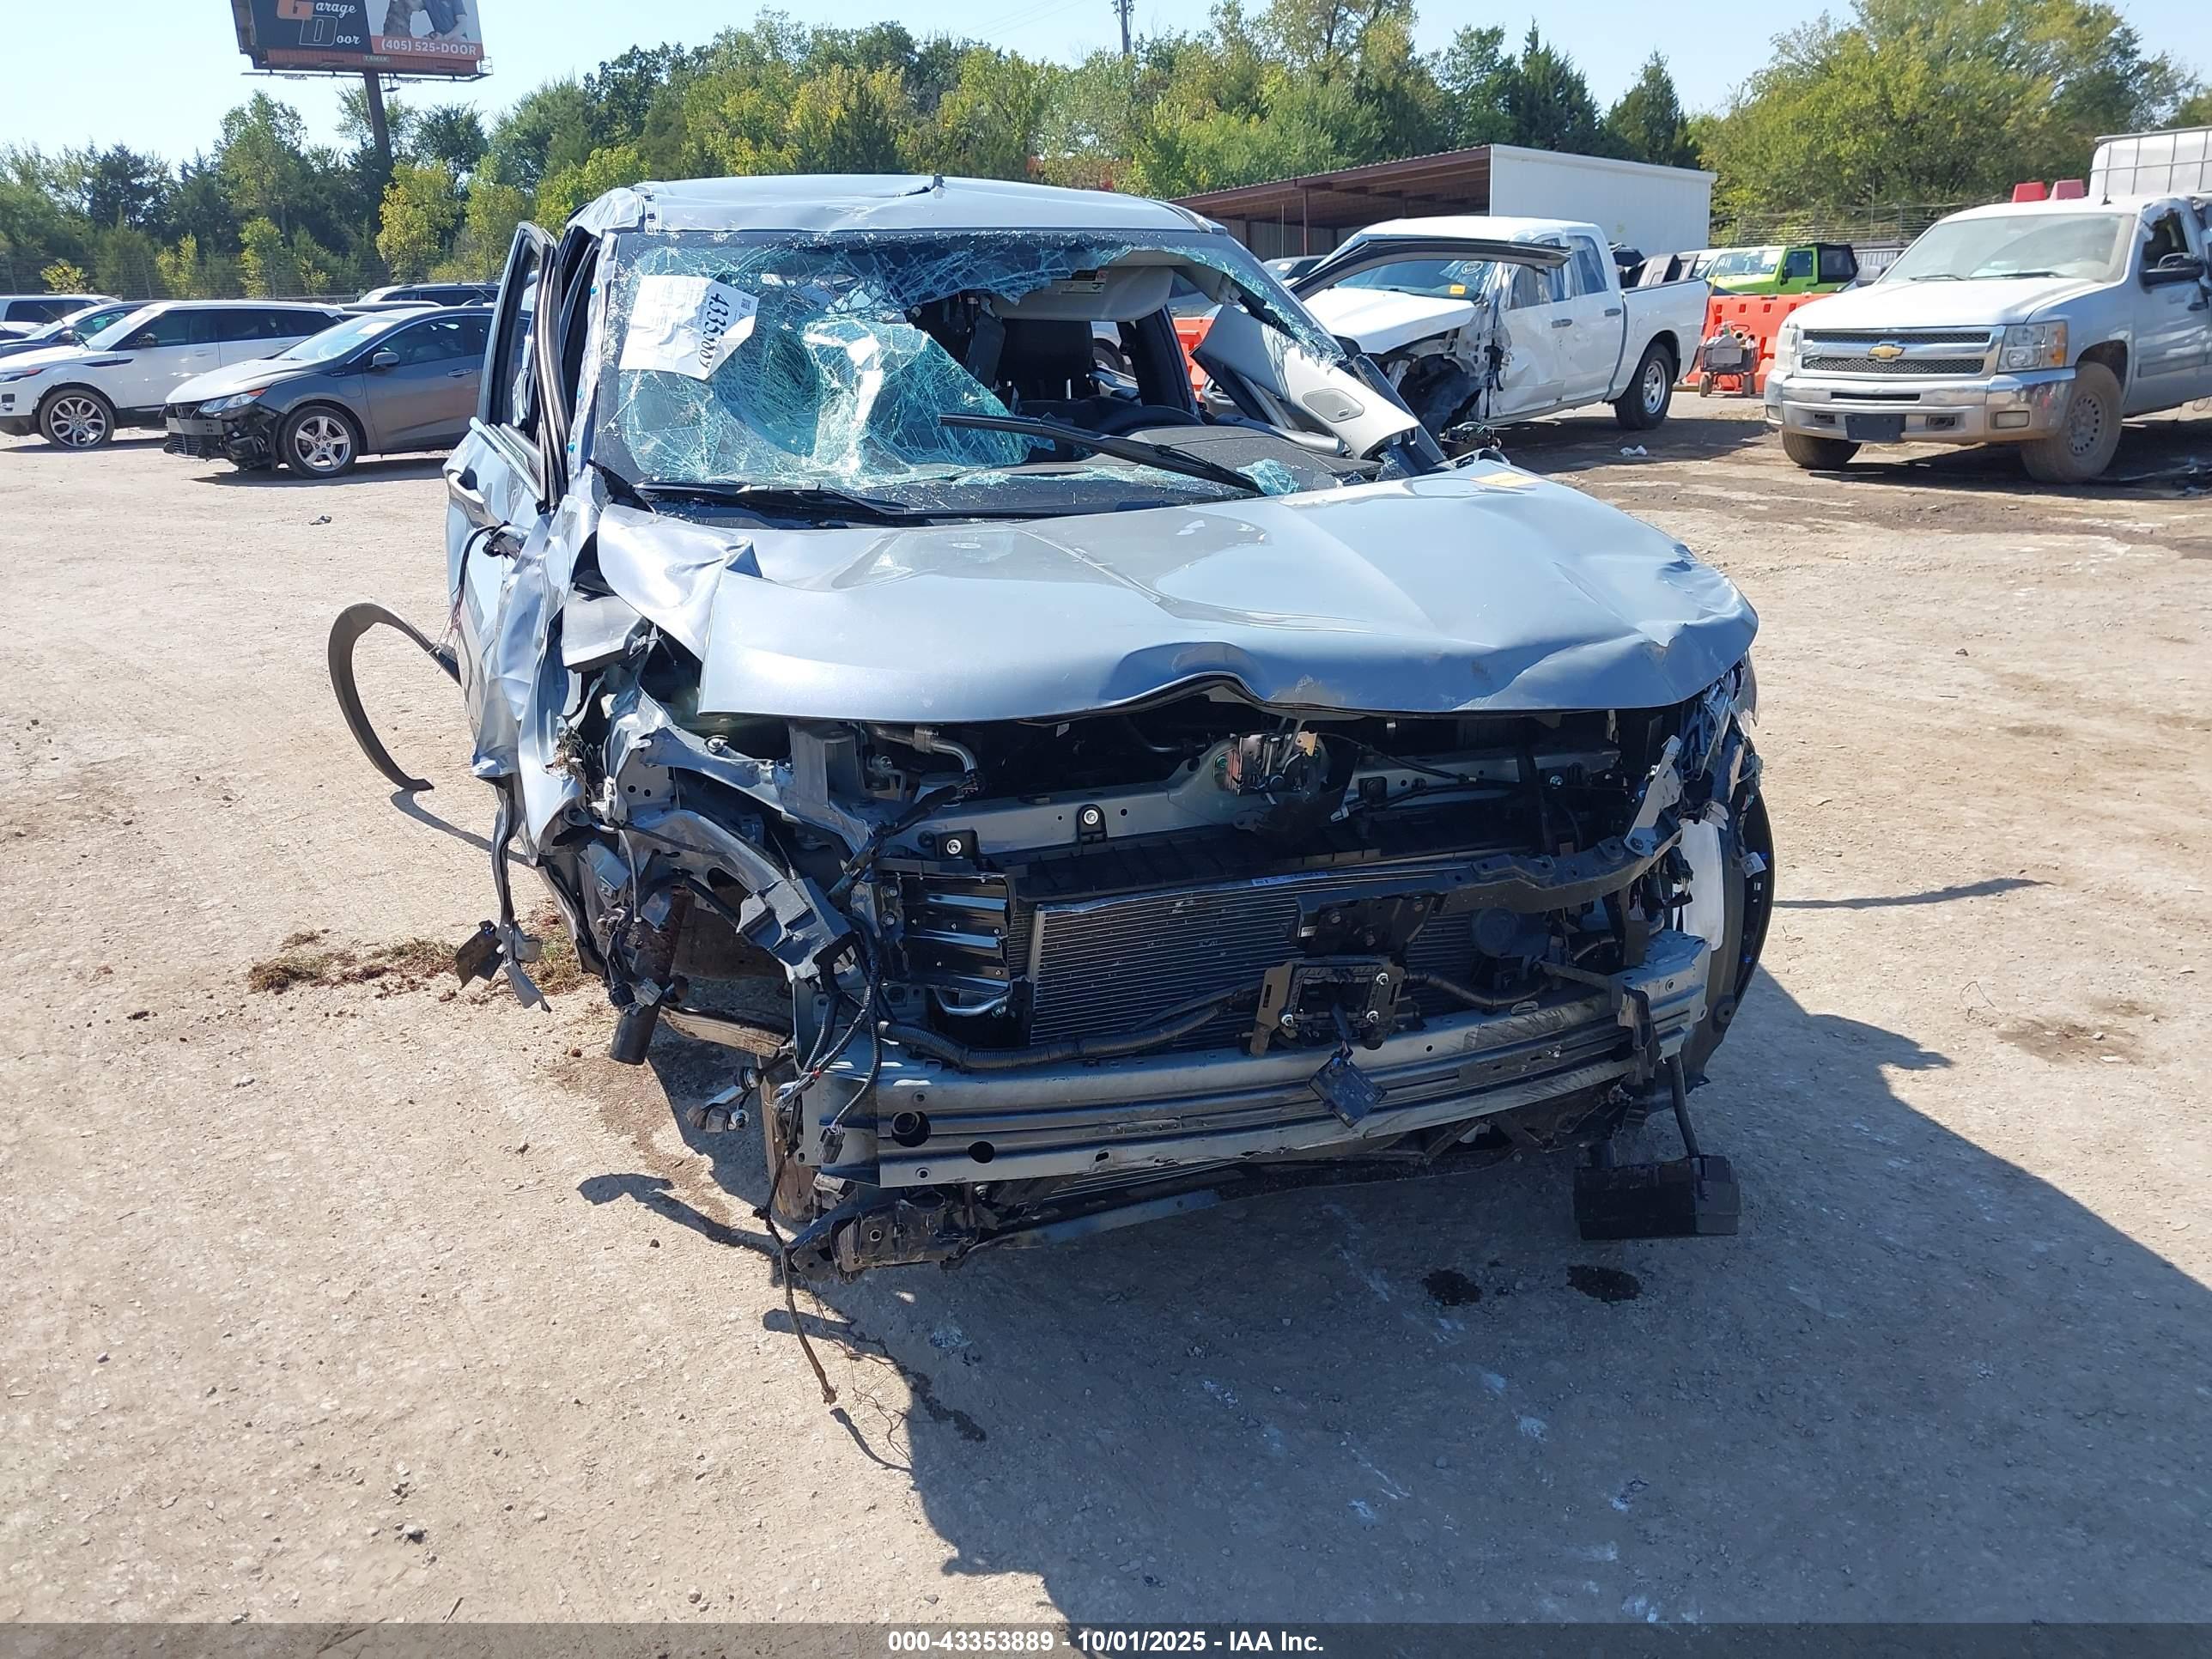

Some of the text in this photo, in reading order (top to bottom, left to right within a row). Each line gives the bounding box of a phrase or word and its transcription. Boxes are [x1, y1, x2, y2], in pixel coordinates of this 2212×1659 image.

[298, 14, 361, 46] Door
[381, 38, 477, 56] (405) 525-DOOR
